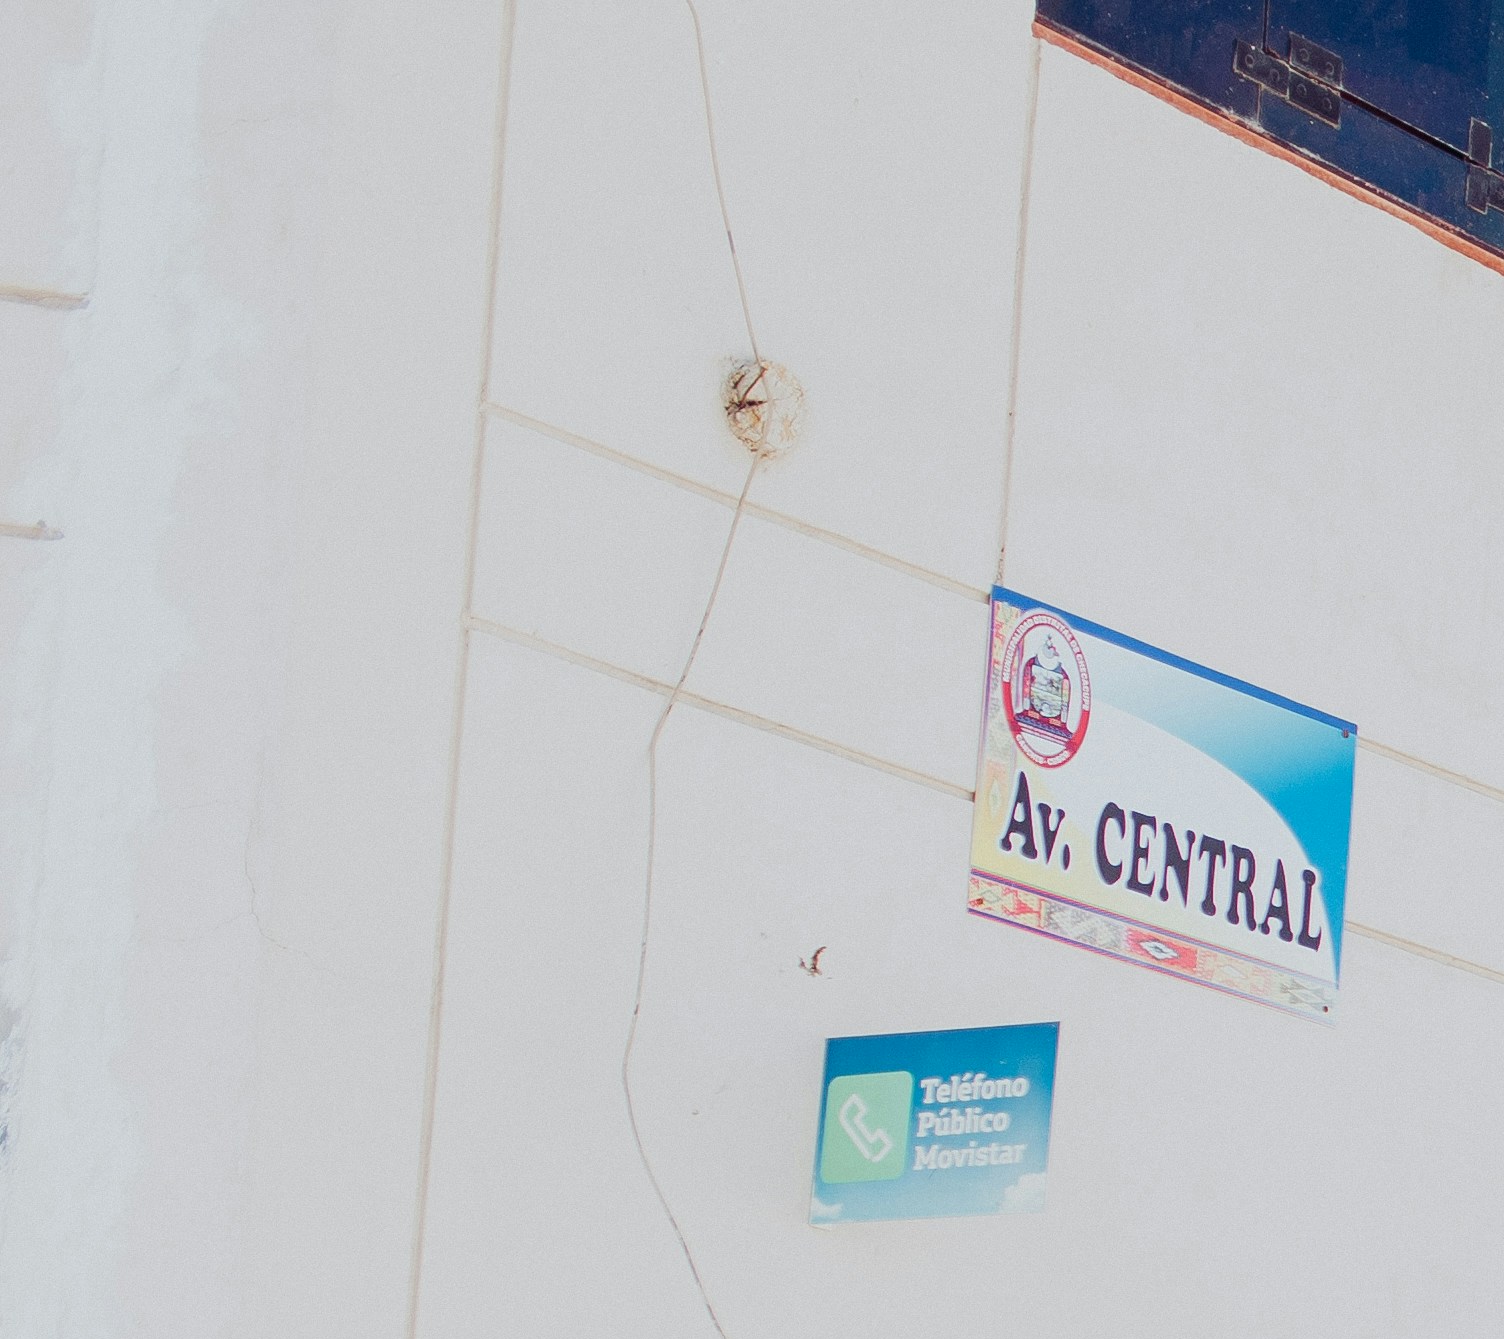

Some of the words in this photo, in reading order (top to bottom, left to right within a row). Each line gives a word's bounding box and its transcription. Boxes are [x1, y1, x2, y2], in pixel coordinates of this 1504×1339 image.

[1000, 771, 1071, 871] Av.
[1096, 801, 1323, 953] CENTRAL
[920, 1072, 1030, 1104] Teléfono
[916, 1108, 1010, 1138] Público
[912, 1140, 1028, 1171] Movistar
